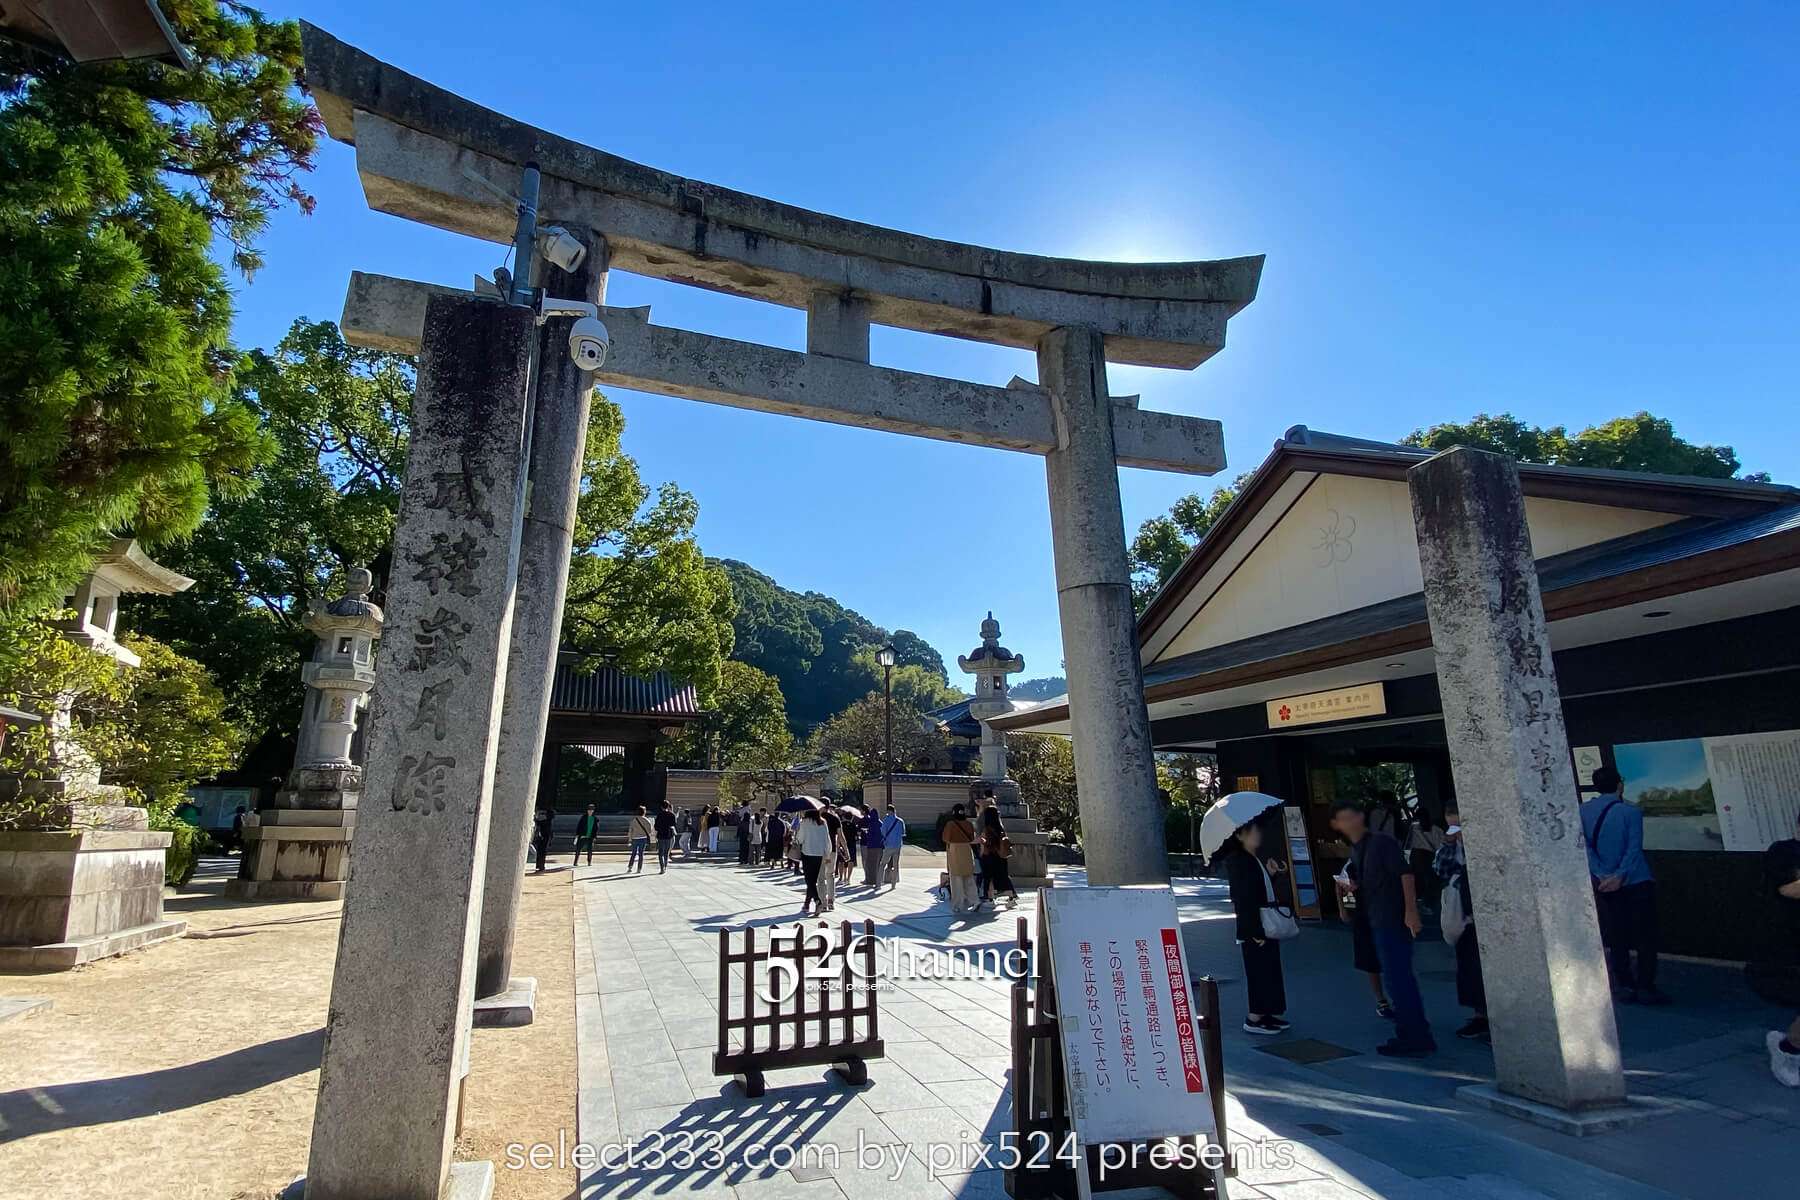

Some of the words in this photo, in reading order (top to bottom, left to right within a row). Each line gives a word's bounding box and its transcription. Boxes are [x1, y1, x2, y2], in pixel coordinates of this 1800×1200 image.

[1078, 941, 1112, 1094] 車を止めないで下さい。
[1164, 943, 1201, 1083] 夜間御参拝の皆様へ
